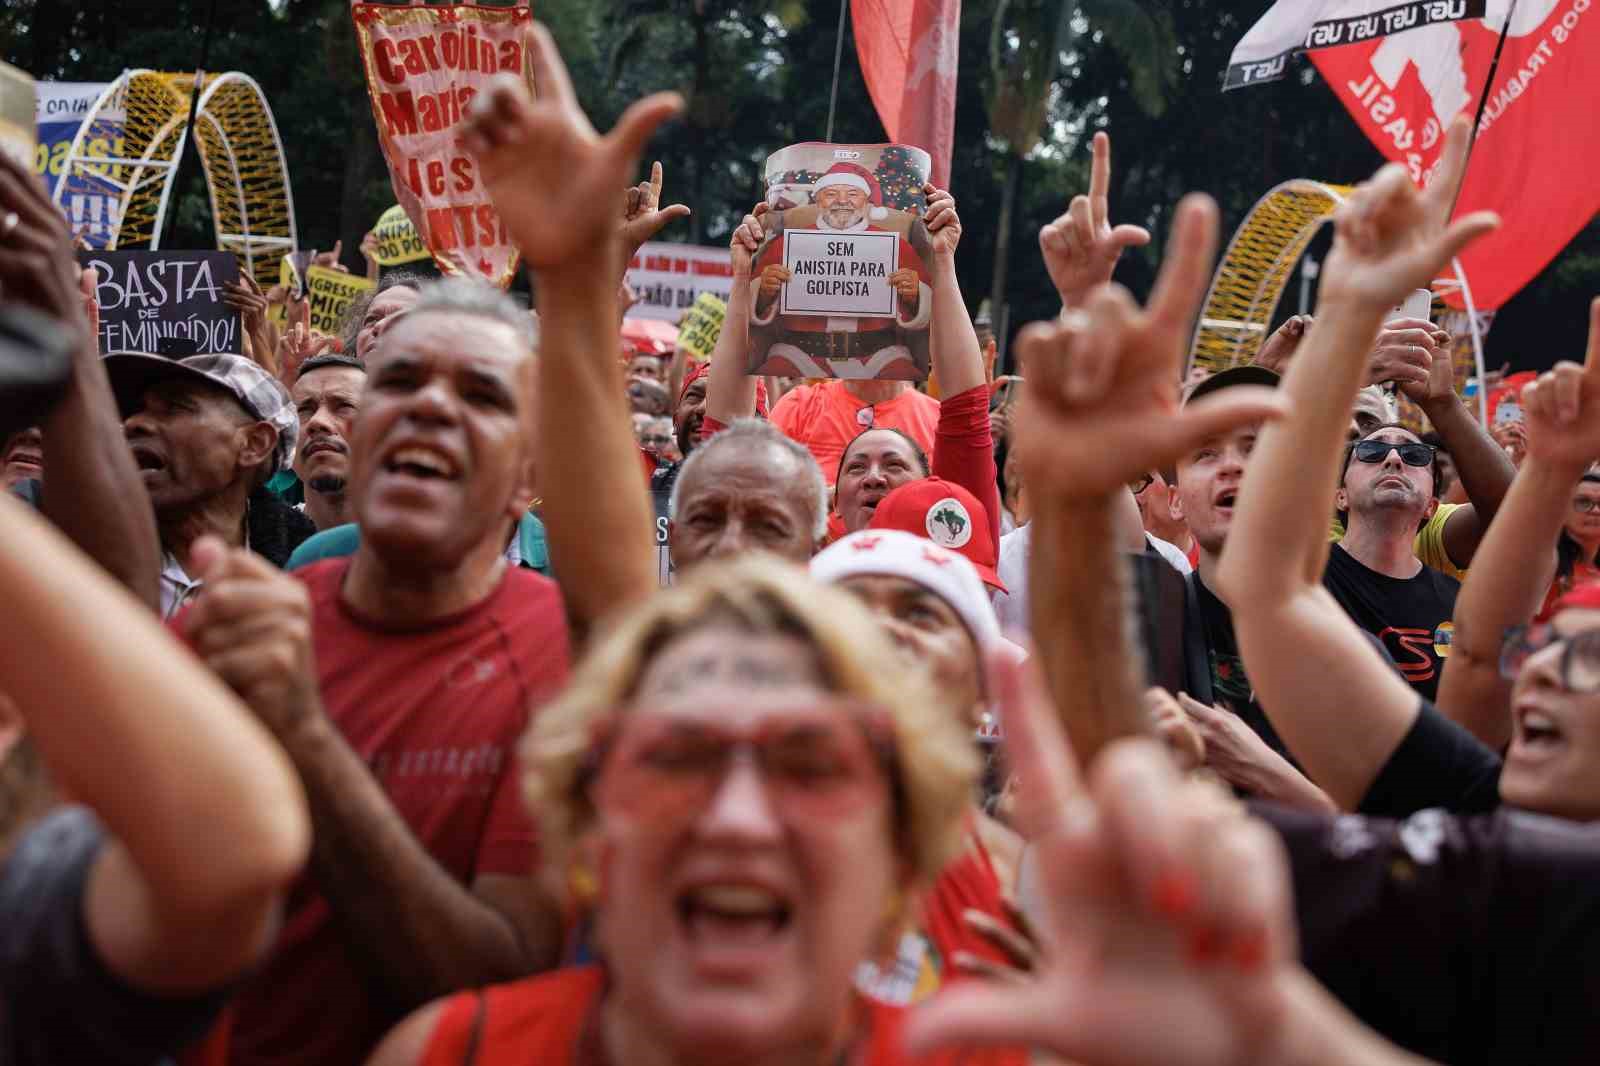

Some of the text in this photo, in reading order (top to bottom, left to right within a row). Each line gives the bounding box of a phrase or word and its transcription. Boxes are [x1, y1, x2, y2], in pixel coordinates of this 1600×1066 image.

[373, 25, 522, 85] Carolina
[827, 241, 854, 257] SEM
[795, 260, 886, 278] ANISTIA PARA
[87, 259, 223, 310] BASTA
[806, 279, 870, 297] GOLPISTA
[137, 307, 161, 320] DE
